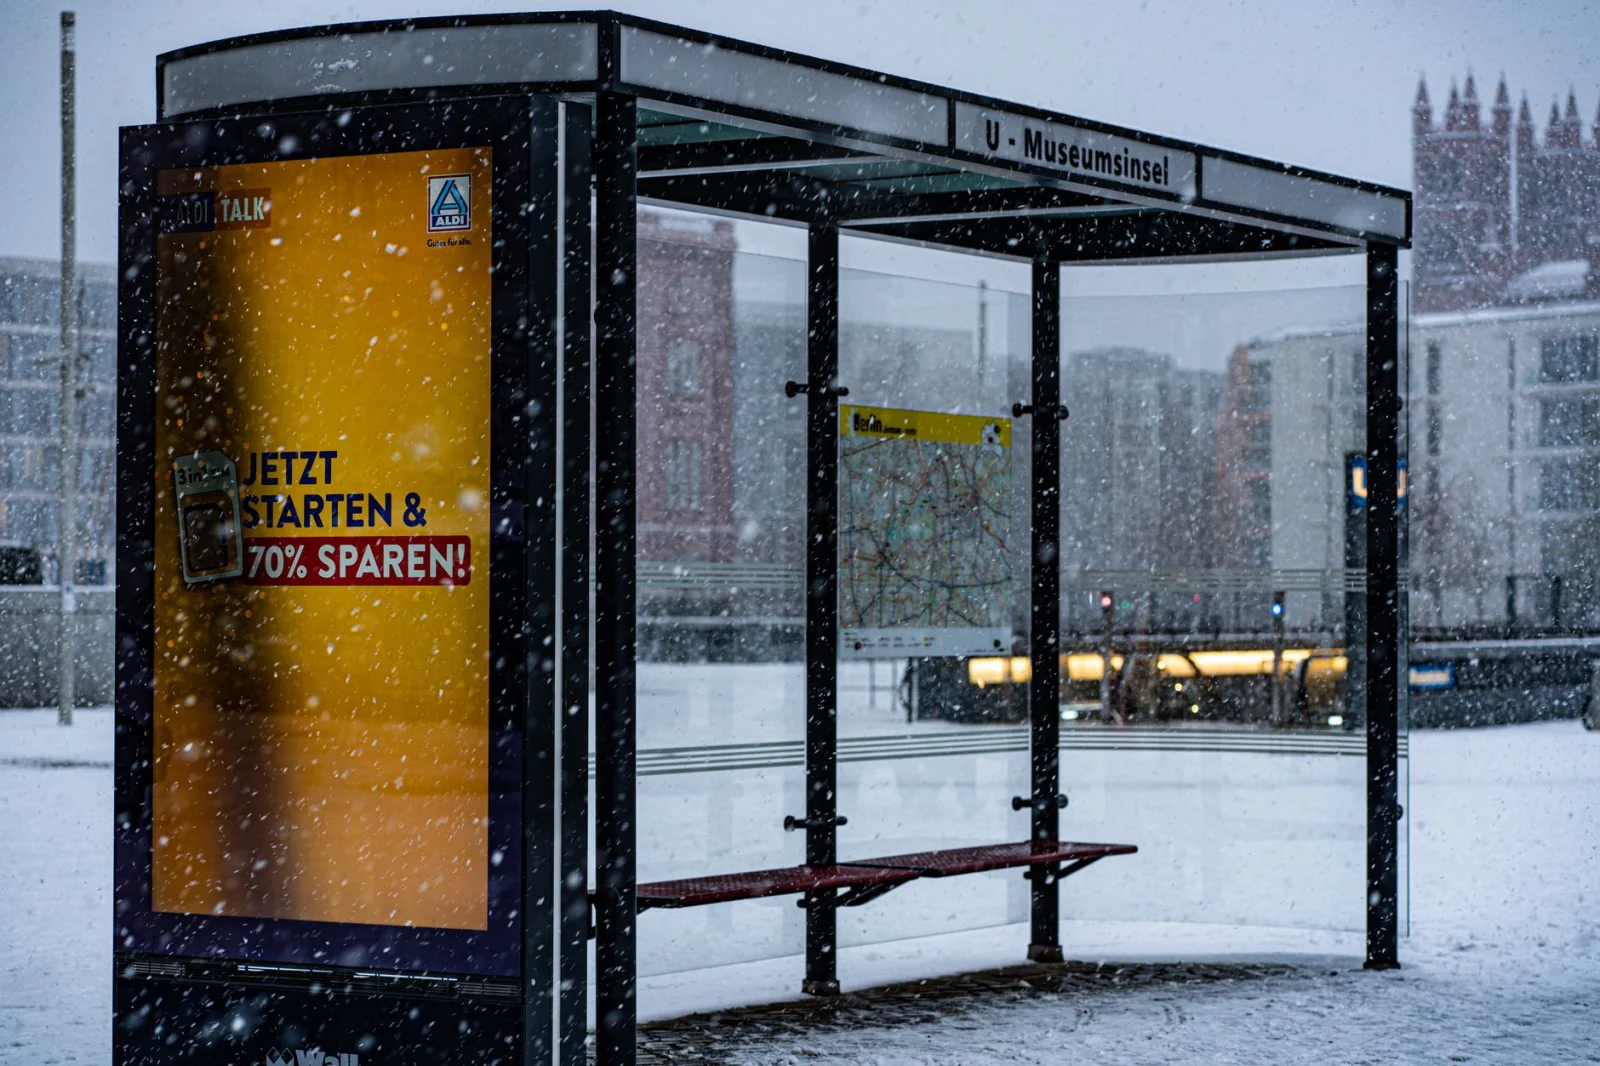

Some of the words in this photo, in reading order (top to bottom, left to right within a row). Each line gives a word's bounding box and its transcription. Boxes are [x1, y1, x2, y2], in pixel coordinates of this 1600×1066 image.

[985, 119, 1000, 152] U
[1024, 128, 1169, 186] Museumsinsel
[220, 196, 265, 222] TALK
[435, 215, 465, 226] ALDI
[427, 238, 447, 248] Gutes
[243, 450, 338, 486] JETZT
[242, 492, 393, 529] STARTEN
[403, 491, 428, 528] &
[247, 543, 307, 579] 70%
[317, 542, 466, 578] SPAREN!
